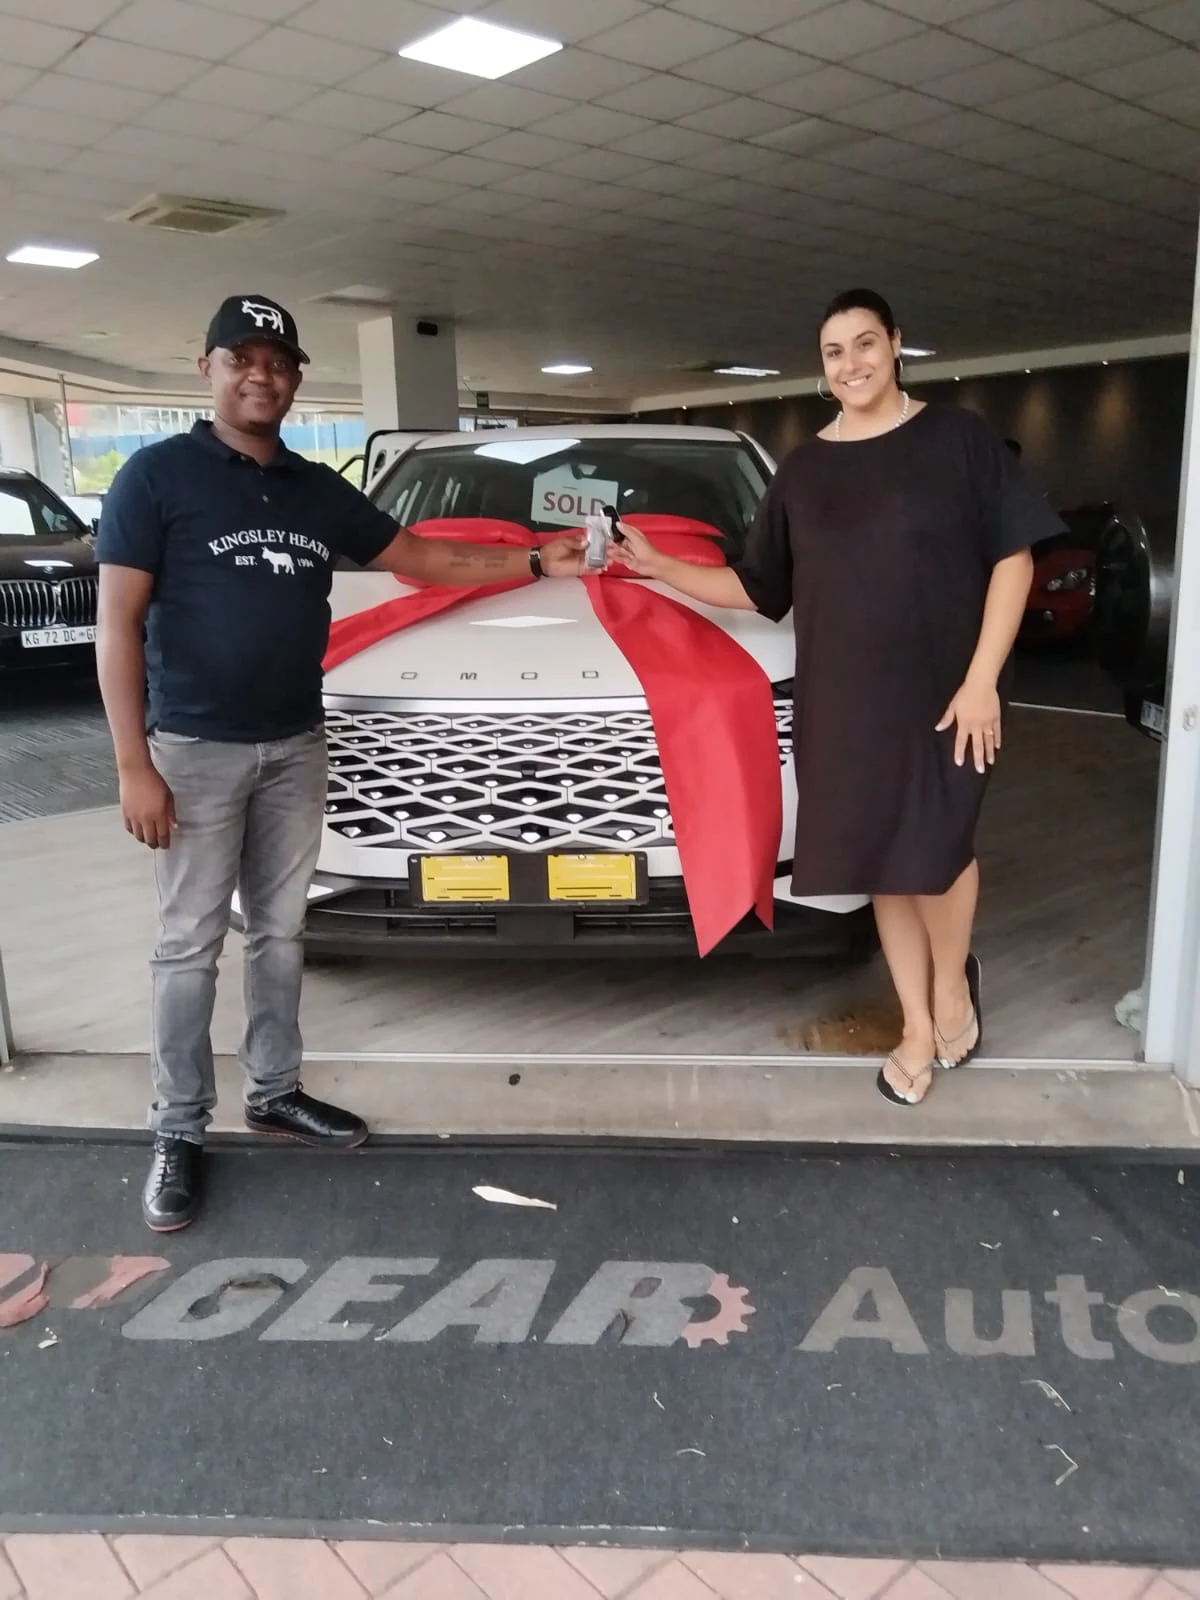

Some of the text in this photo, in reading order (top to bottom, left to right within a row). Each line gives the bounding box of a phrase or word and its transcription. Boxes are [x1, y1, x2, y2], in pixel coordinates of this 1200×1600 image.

[543, 491, 608, 517] SOLD
[208, 529, 330, 562] KINGSLEY HEATH
[235, 555, 258, 566] EST.
[24, 632, 40, 646] KG
[44, 631, 58, 644] 72
[63, 629, 76, 642] DC
[121, 1257, 718, 1348] GEAR
[795, 1265, 1200, 1366] Auto
